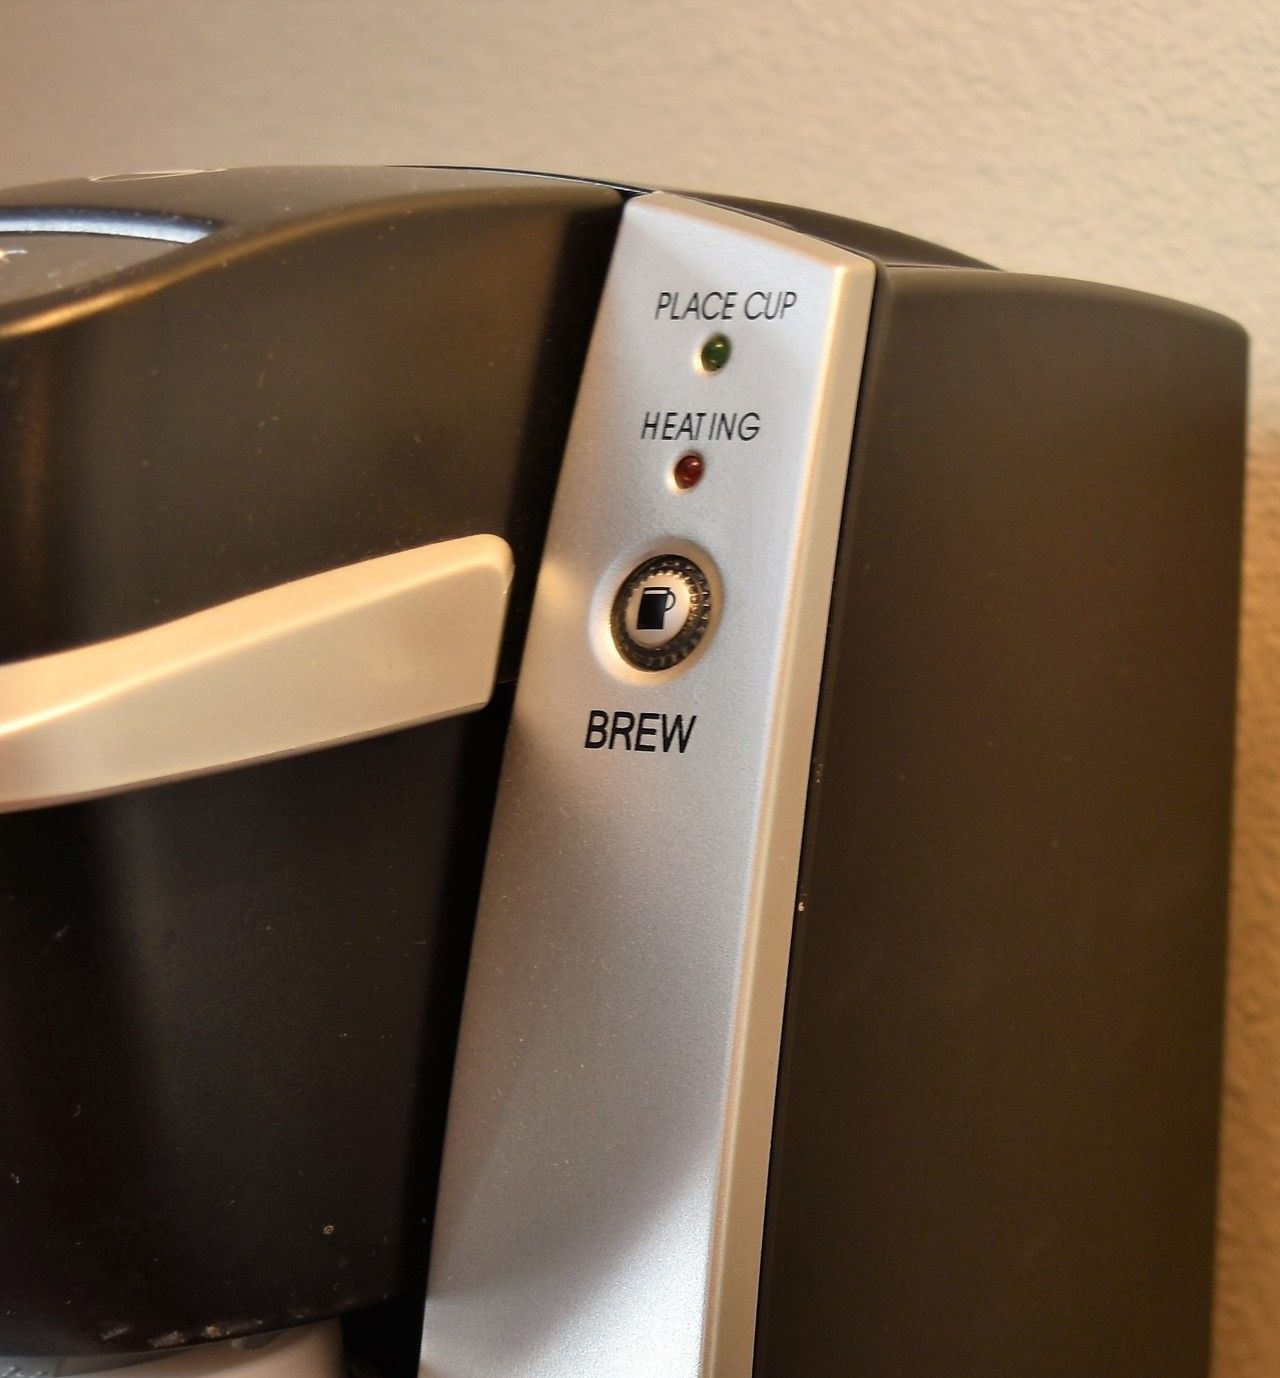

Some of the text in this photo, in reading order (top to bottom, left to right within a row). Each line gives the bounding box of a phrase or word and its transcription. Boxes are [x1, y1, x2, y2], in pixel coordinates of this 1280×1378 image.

[655, 291, 798, 320] PLACE CUP
[641, 411, 761, 441] HEATING
[584, 710, 697, 754] BREW
